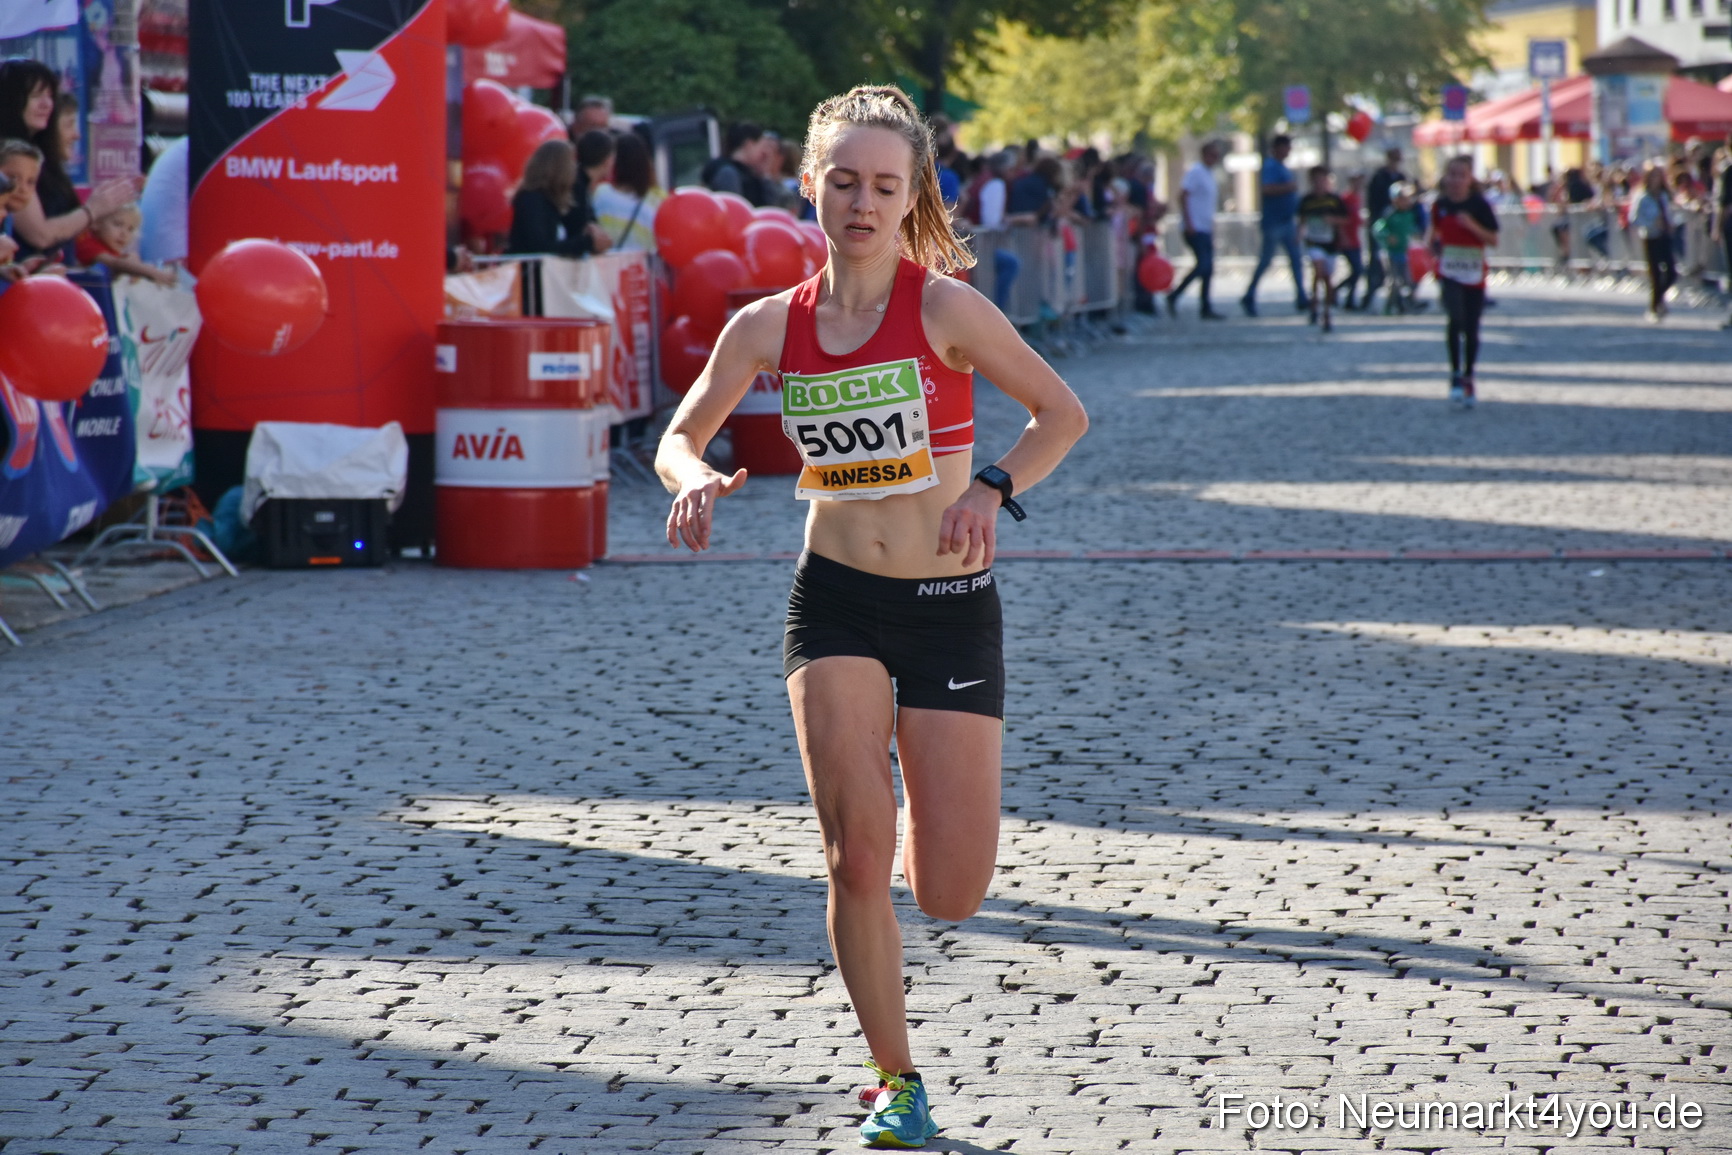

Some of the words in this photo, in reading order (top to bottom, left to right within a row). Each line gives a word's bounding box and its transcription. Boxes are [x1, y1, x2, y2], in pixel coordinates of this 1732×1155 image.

[249, 73, 281, 92] THE
[283, 74, 329, 92] NEXT
[226, 91, 251, 108] 100
[253, 92, 308, 109] YEARS
[225, 157, 282, 178] BMW
[288, 159, 398, 185] Laufsport
[752, 373, 782, 394] AV
[788, 367, 909, 411] BOCK
[76, 416, 121, 437] MOBILE
[797, 412, 907, 457] 5001
[913, 411, 920, 419] S
[917, 579, 968, 596] NIKE
[971, 571, 992, 591] PRO
